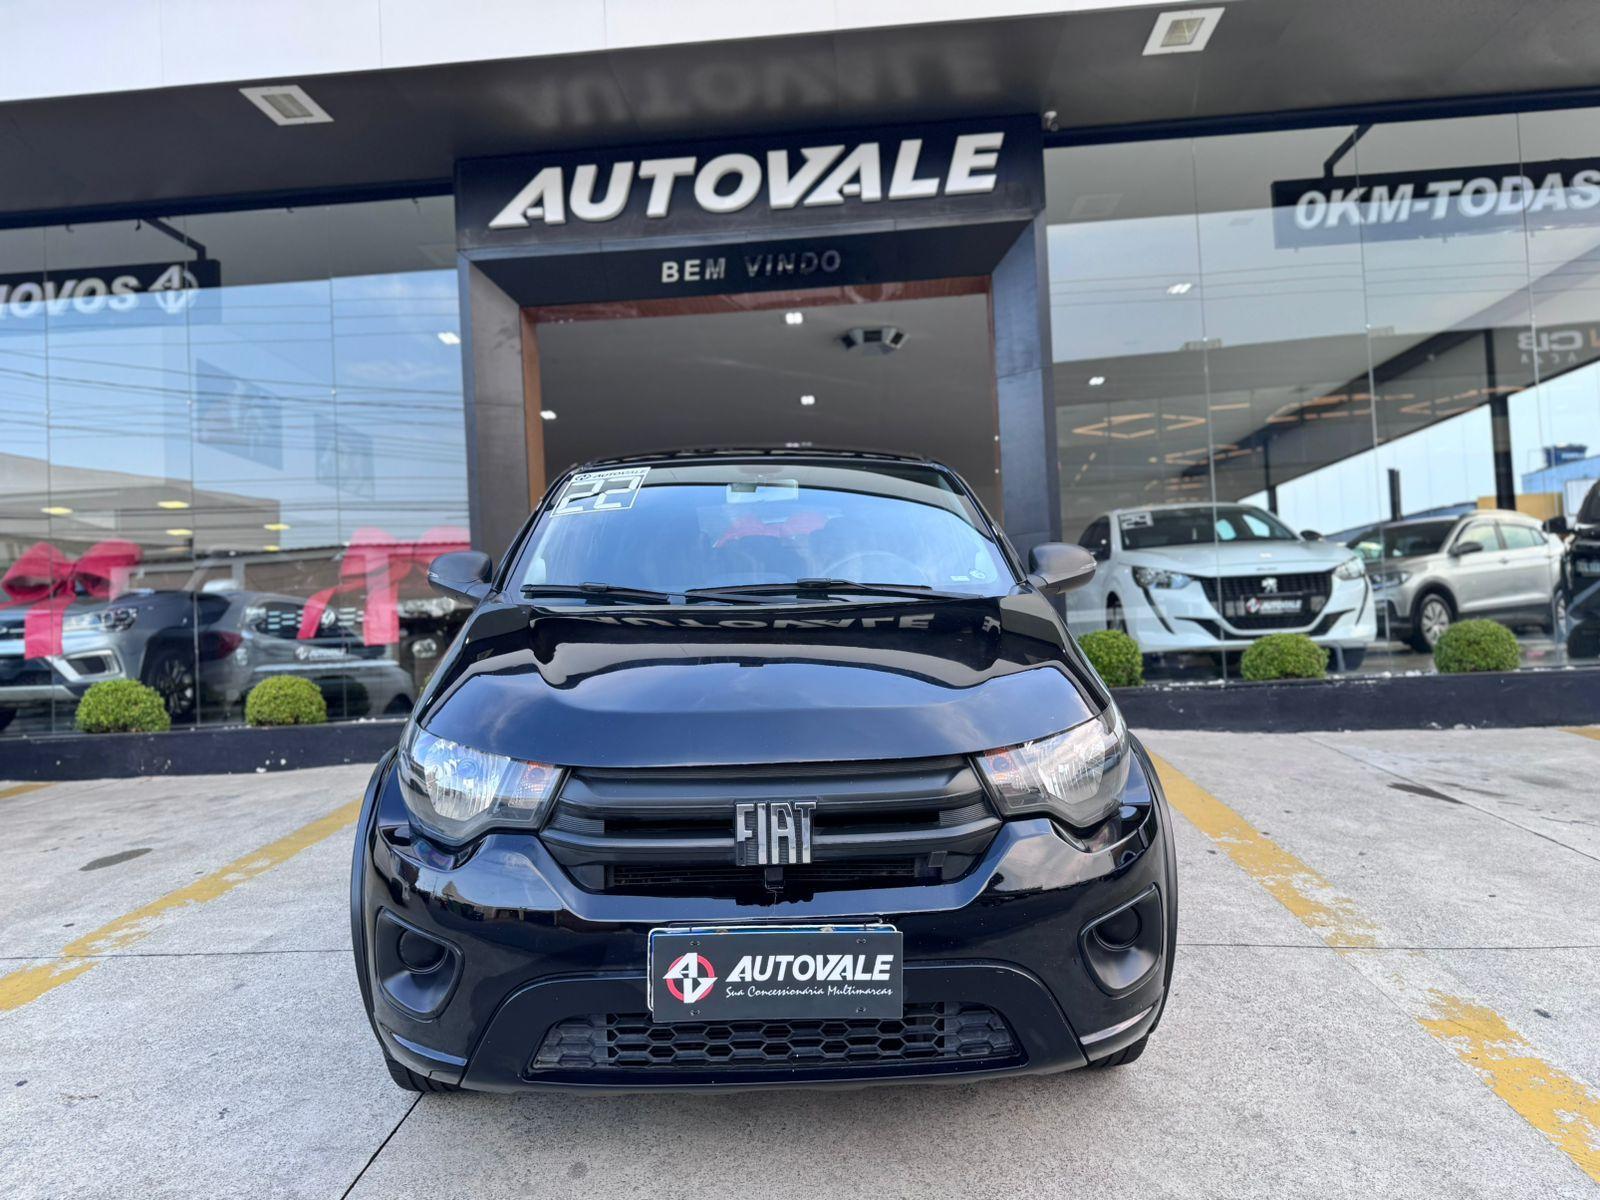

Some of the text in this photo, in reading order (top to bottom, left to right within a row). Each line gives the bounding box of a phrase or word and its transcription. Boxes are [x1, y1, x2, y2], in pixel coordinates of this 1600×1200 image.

[488, 132, 1005, 229] AUTOVALE
[661, 250, 842, 283] BEM VINDO
[555, 476, 641, 514] 22
[736, 802, 816, 865] FIAT
[725, 954, 894, 982] AUTOVALE
[725, 984, 893, 998] Sua Concessionária Multimarcas
